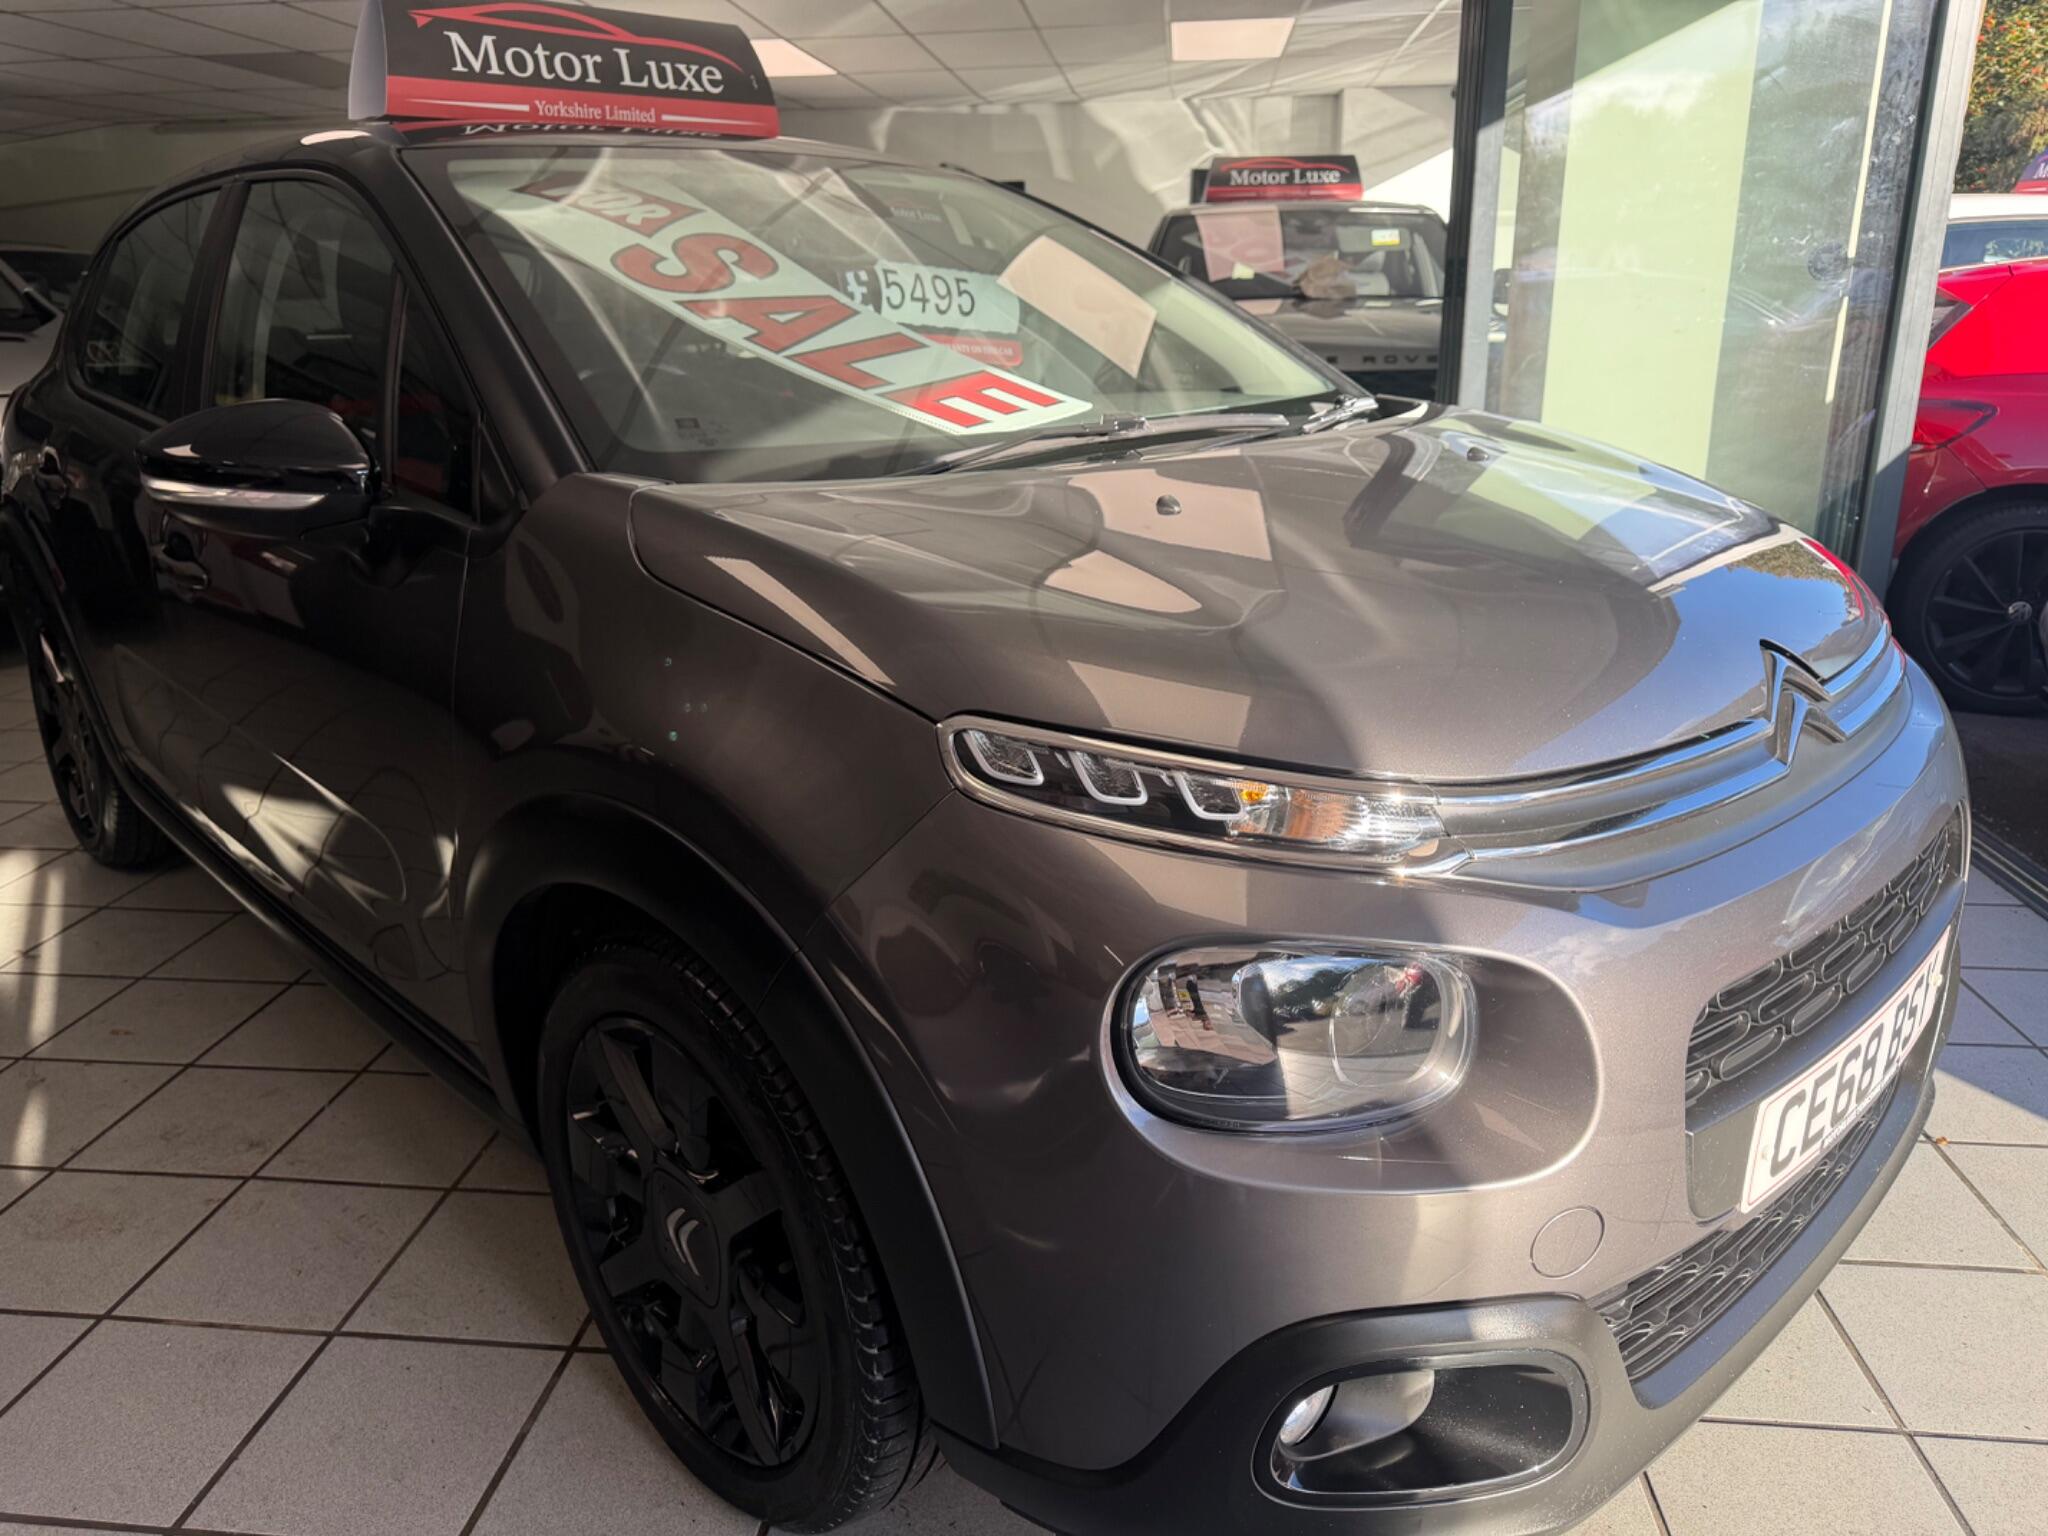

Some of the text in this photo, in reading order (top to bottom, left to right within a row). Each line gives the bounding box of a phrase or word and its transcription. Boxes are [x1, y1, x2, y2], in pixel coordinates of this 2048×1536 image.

[443, 30, 725, 94] Motor Luxe
[534, 100, 656, 123] Yorkshire Limited
[1230, 168, 1341, 185] Motor Luxe
[611, 232, 1064, 428] SALE
[1362, 354, 1438, 364] ROVE
[1770, 1021, 1884, 1178] CE68
